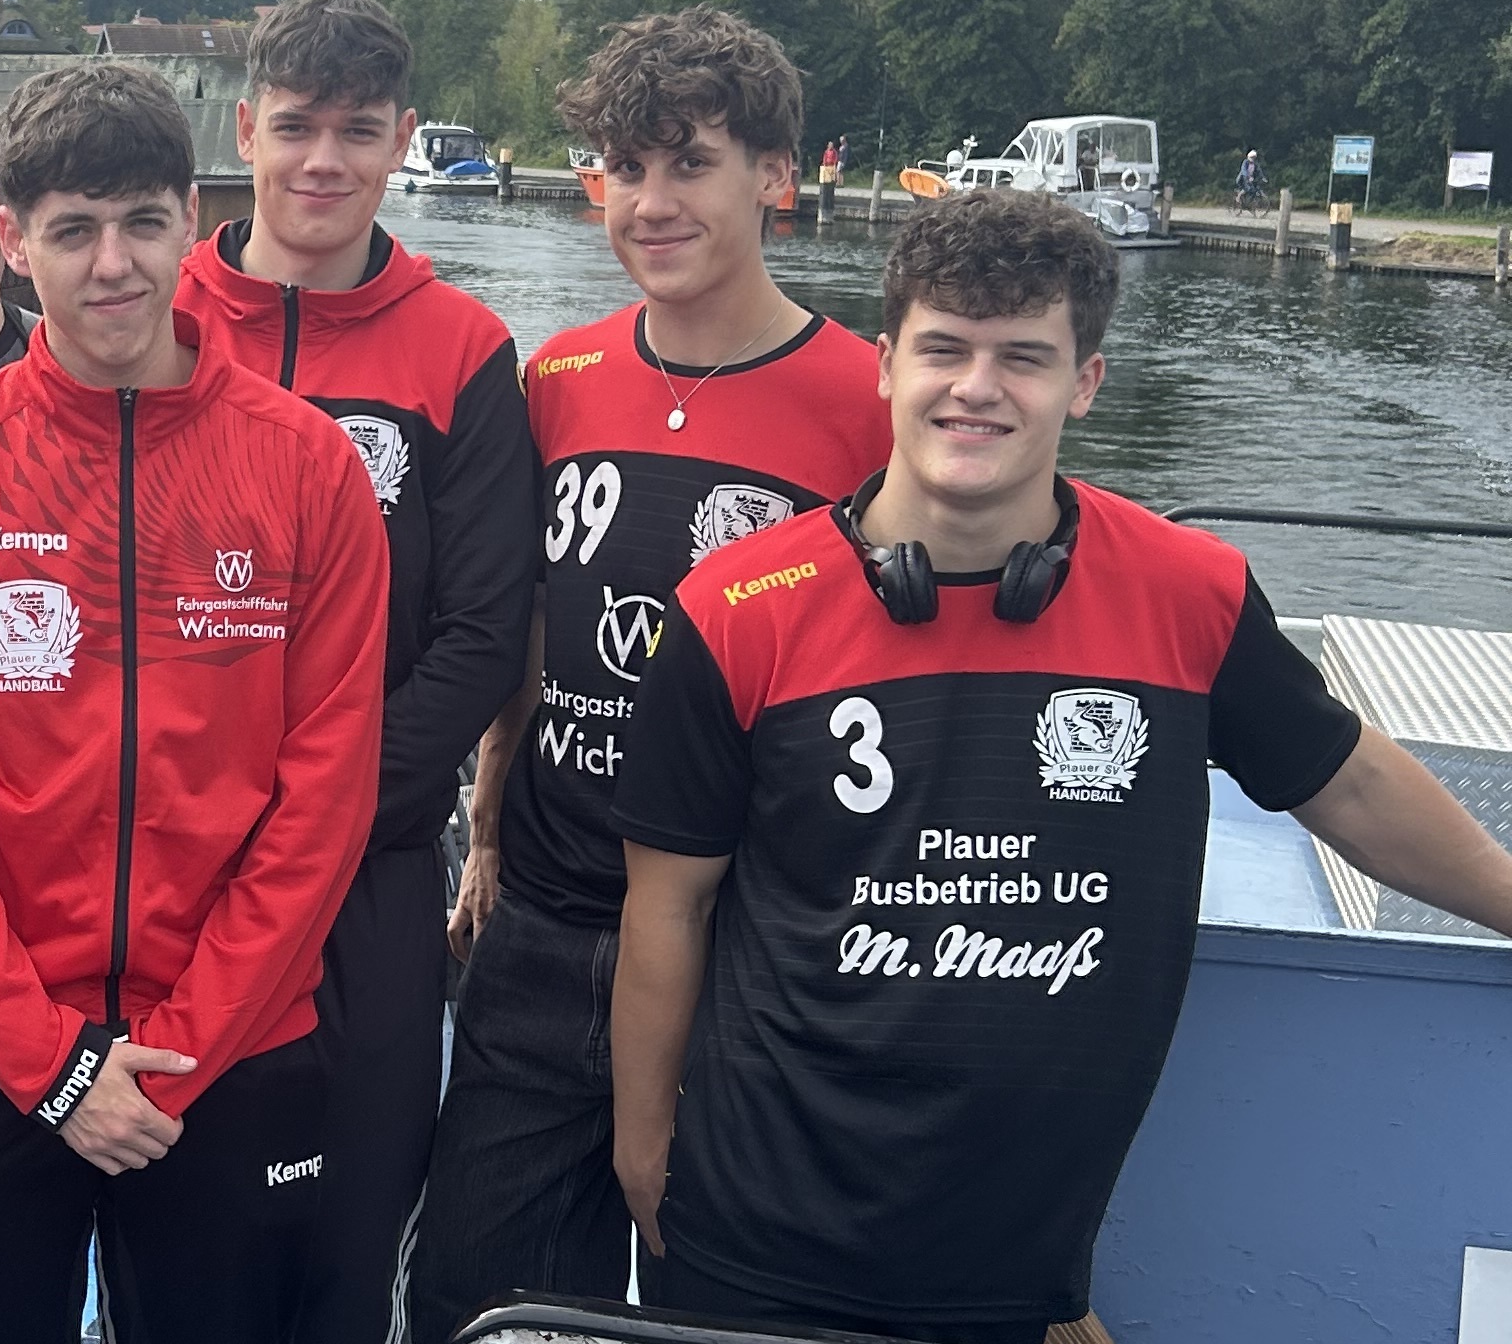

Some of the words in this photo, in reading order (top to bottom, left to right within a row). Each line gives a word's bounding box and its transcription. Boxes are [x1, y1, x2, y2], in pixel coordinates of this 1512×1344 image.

[538, 350, 605, 379] Kempa
[545, 461, 622, 565] 39
[722, 560, 819, 607] Kempa
[176, 596, 288, 613] Fahrgastschifffahrt
[177, 615, 286, 640] Wichmann
[0, 655, 37, 666] Plauer
[829, 696, 894, 814] 3
[1059, 763, 1100, 774] Plauer
[1049, 787, 1125, 803] HANDBALL
[918, 828, 1037, 861] Plauer
[851, 872, 1041, 906] Busbetrieb
[1053, 871, 1109, 904] UG
[838, 923, 921, 978] M.
[932, 924, 1105, 996] Maaß
[37, 1048, 100, 1126] Kempa
[267, 1154, 323, 1187] Kemp
